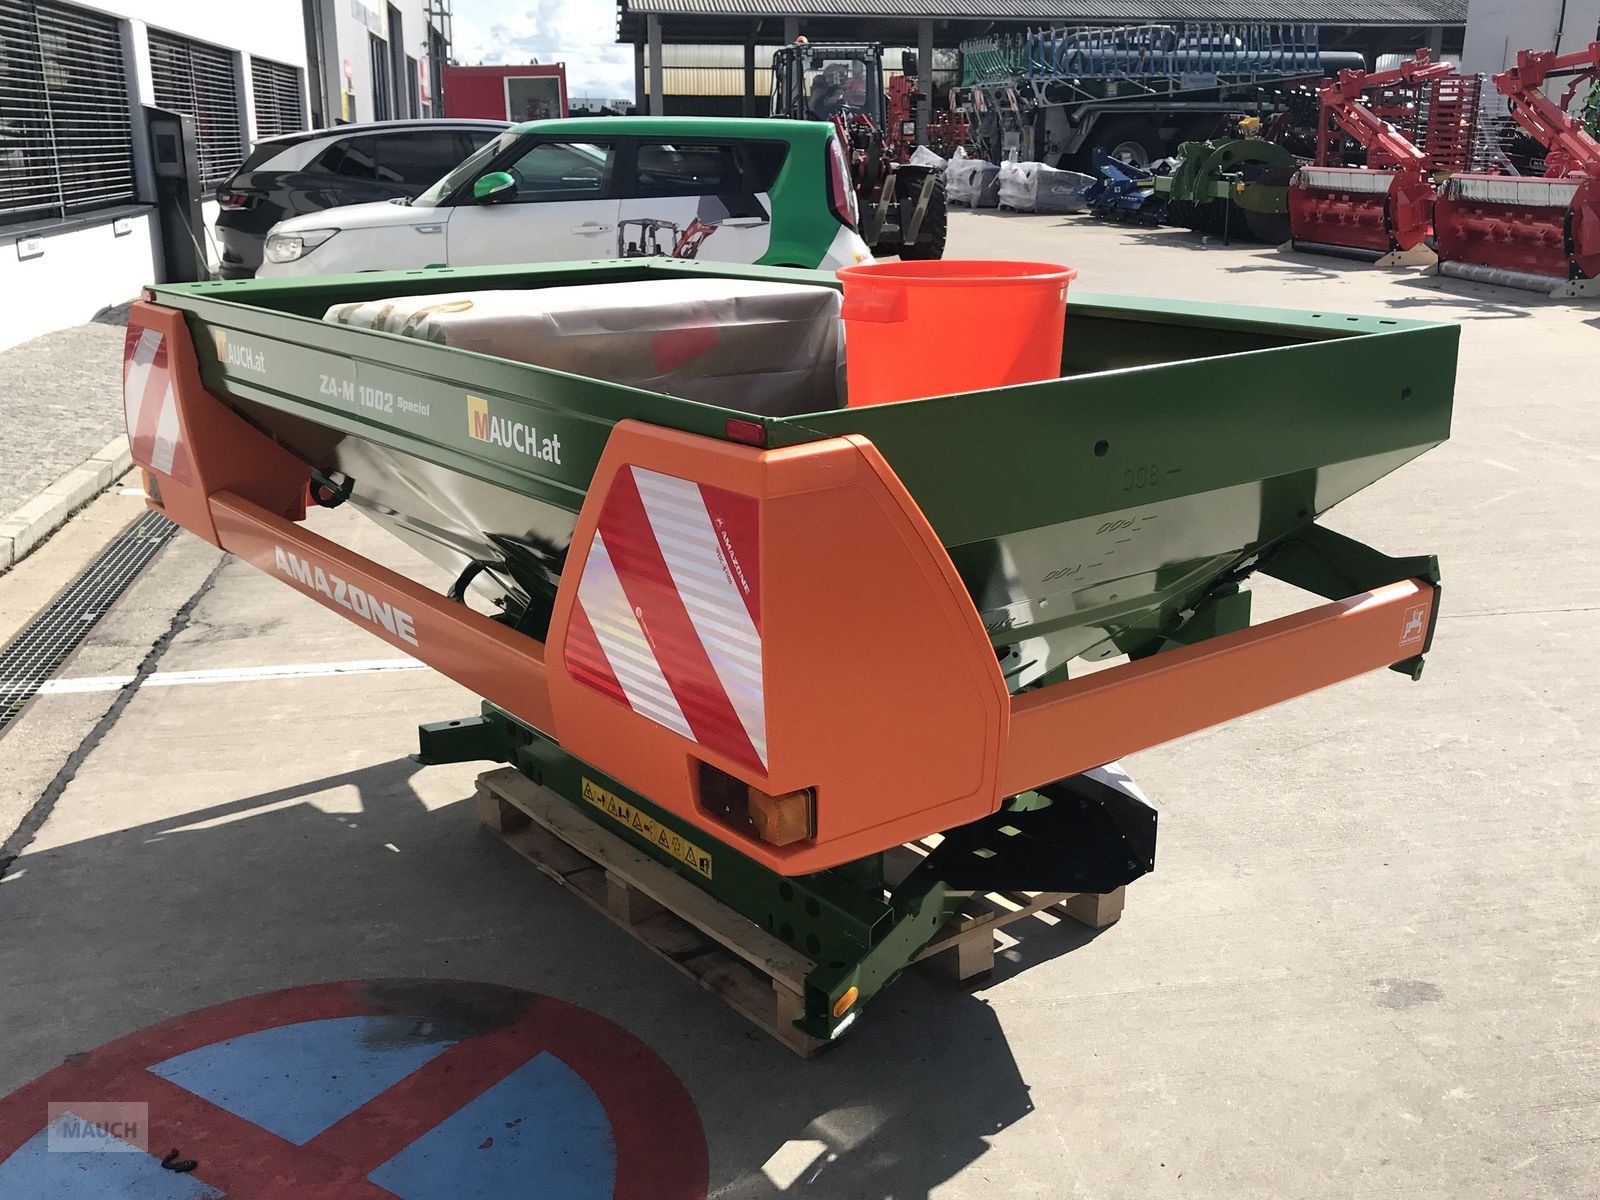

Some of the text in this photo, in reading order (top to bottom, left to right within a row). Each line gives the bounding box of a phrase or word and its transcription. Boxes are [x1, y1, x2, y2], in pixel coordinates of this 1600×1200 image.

[217, 341, 266, 374] MAUCH.at
[320, 374, 430, 416] ZA-M 1002 Special
[473, 410, 562, 465] MAUCH.at
[721, 531, 751, 595] AMAZONE
[274, 545, 419, 648] AMAZONE
